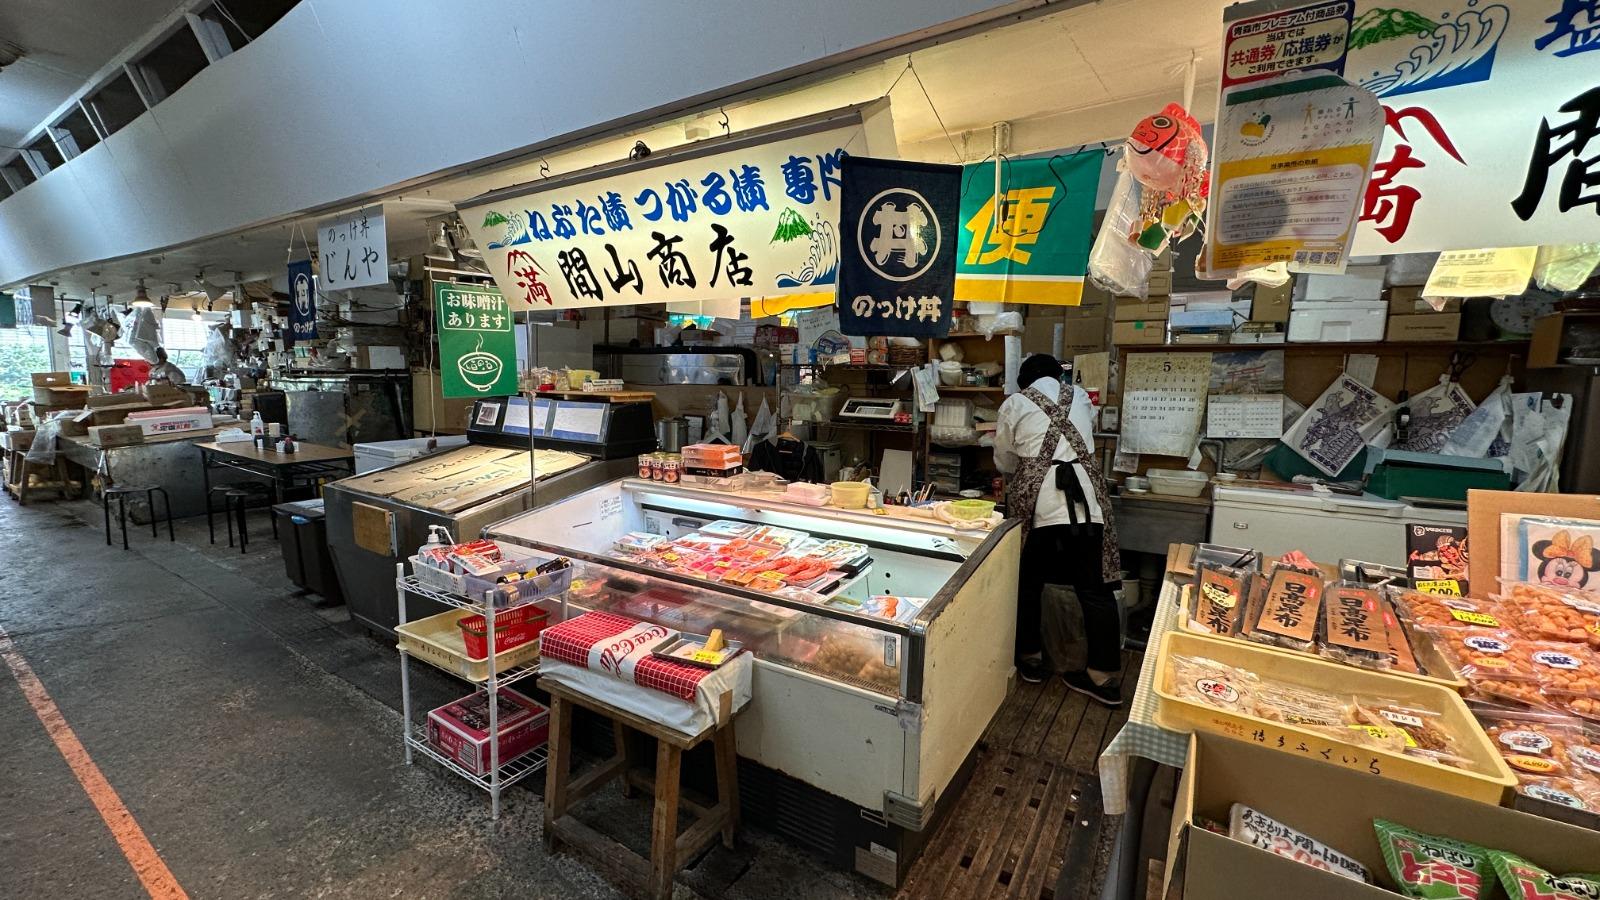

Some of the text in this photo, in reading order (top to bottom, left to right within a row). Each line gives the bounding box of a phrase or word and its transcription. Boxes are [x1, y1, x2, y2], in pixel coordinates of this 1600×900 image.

[1233, 8, 1346, 35] 青森市プレミアム付商品券
[1266, 27, 1306, 43] 当店では
[1247, 55, 1320, 74] ご利用できます。
[525, 191, 633, 240] ねぶた漬
[634, 164, 769, 223] つがる漬
[328, 215, 370, 244] のっけ丼
[964, 186, 1056, 266] 便
[325, 246, 379, 284] じんや
[557, 223, 754, 302] 間山商店
[446, 292, 505, 311] お味噌汁
[851, 294, 942, 323] のっけ丼
[447, 311, 506, 329] あります
[1163, 361, 1172, 372] 5
[1207, 582, 1231, 633] 日昆布
[1272, 582, 1307, 627] 日高昆布
[1339, 597, 1371, 641] 日高昆布
[600, 625, 668, 678] Coca-Cola
